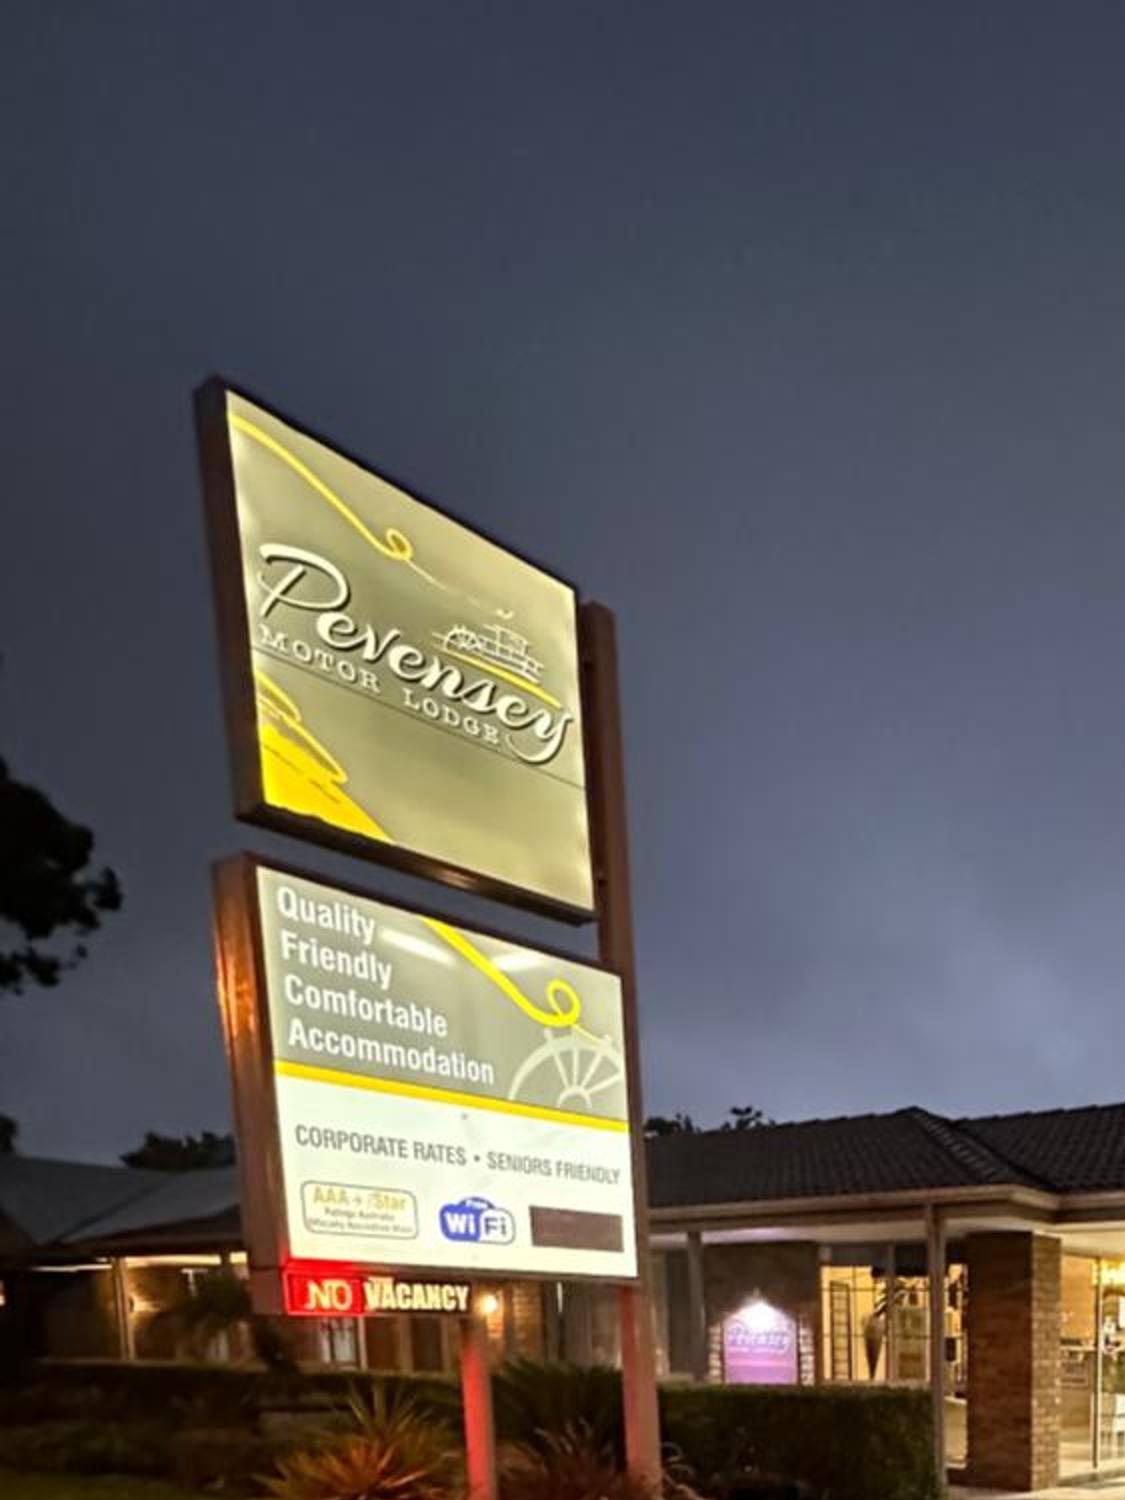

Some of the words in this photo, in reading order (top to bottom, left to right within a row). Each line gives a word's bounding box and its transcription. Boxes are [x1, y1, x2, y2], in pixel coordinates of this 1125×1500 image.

[257, 543, 574, 764] Pevensey
[257, 623, 382, 693] MOTOR
[402, 687, 500, 745] LODGE
[277, 885, 375, 945] Quality
[281, 930, 392, 990] Friendly
[285, 974, 448, 1037] Comfortable
[288, 1018, 495, 1085] Accommodation
[295, 1124, 408, 1158] CORPORATE
[413, 1140, 467, 1166] RATES
[487, 1150, 552, 1177] SENIORS
[556, 1160, 621, 1185] FRIENDLY
[306, 1279, 353, 1312] NO
[364, 1275, 469, 1312] VACANCY
